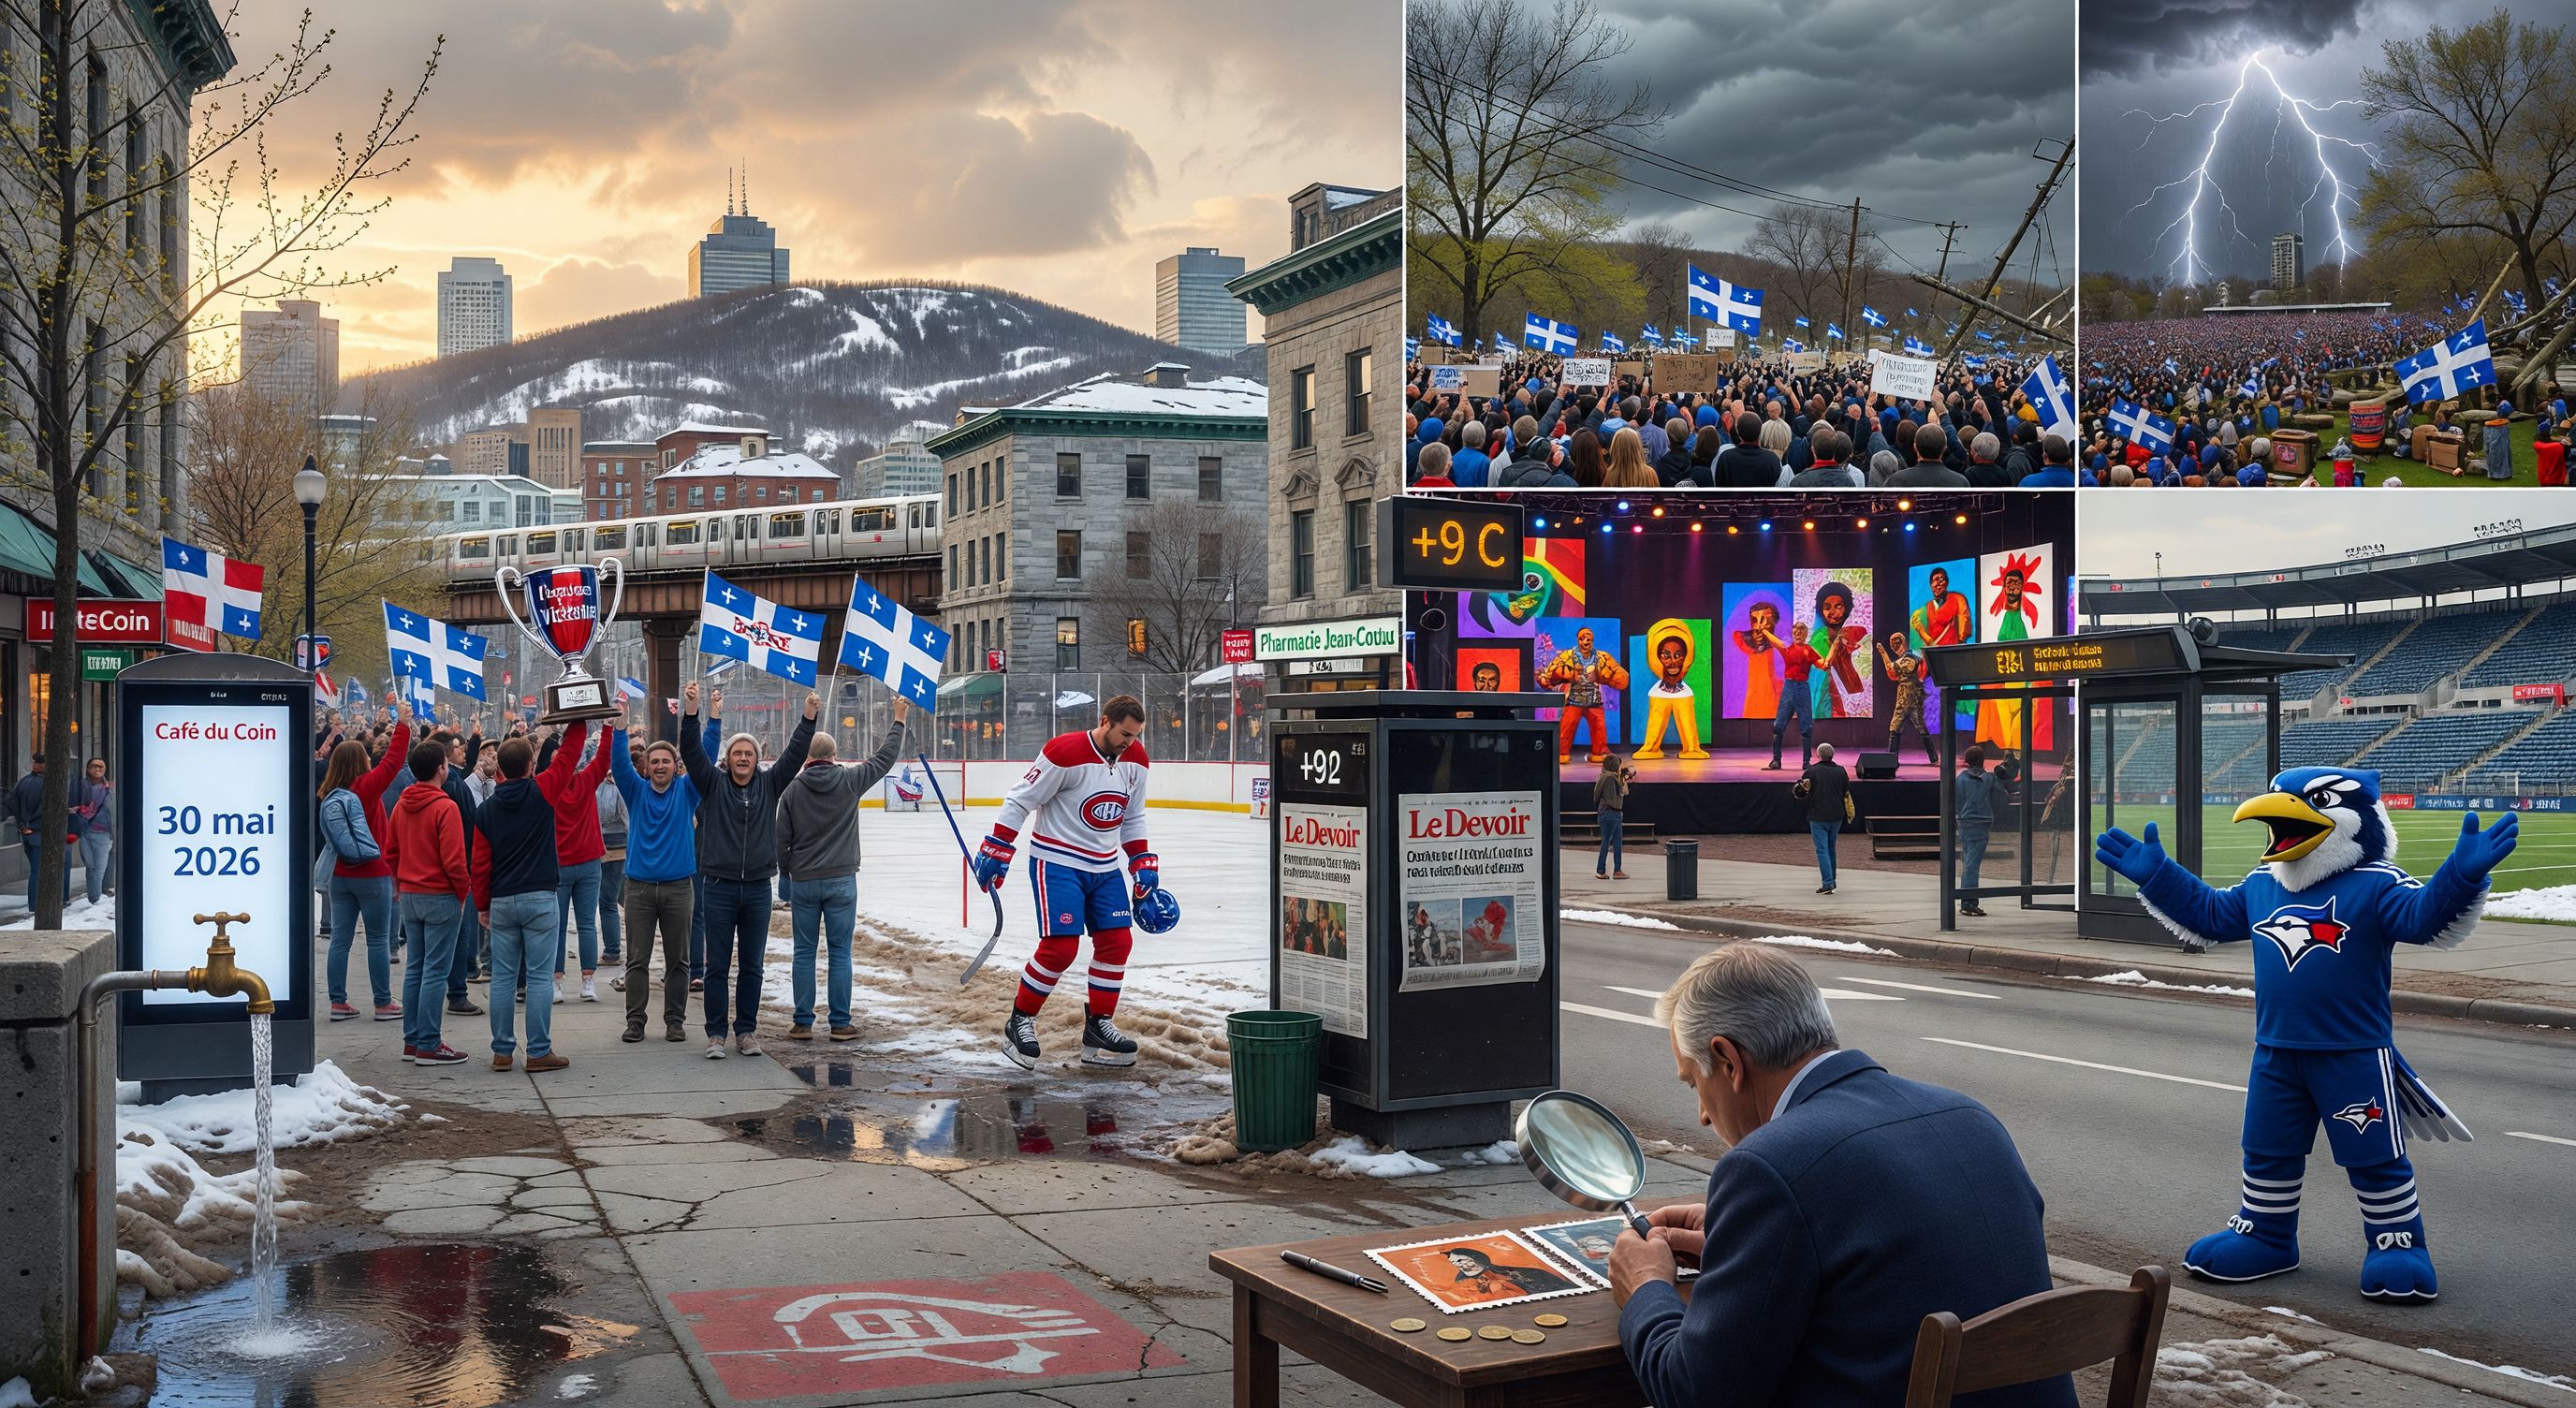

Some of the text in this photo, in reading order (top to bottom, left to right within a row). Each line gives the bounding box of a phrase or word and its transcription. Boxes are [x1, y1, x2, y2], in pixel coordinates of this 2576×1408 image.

[1412, 520, 1505, 568] +9 C
[1261, 630, 1321, 653] Pharmacie
[155, 722, 276, 741] Café du Coin
[1300, 749, 1341, 785] +92
[158, 804, 274, 835] 30 mai
[1284, 816, 1361, 848] Le Devoir
[1408, 806, 1531, 839] Le Devoir
[173, 846, 260, 876] 2026
